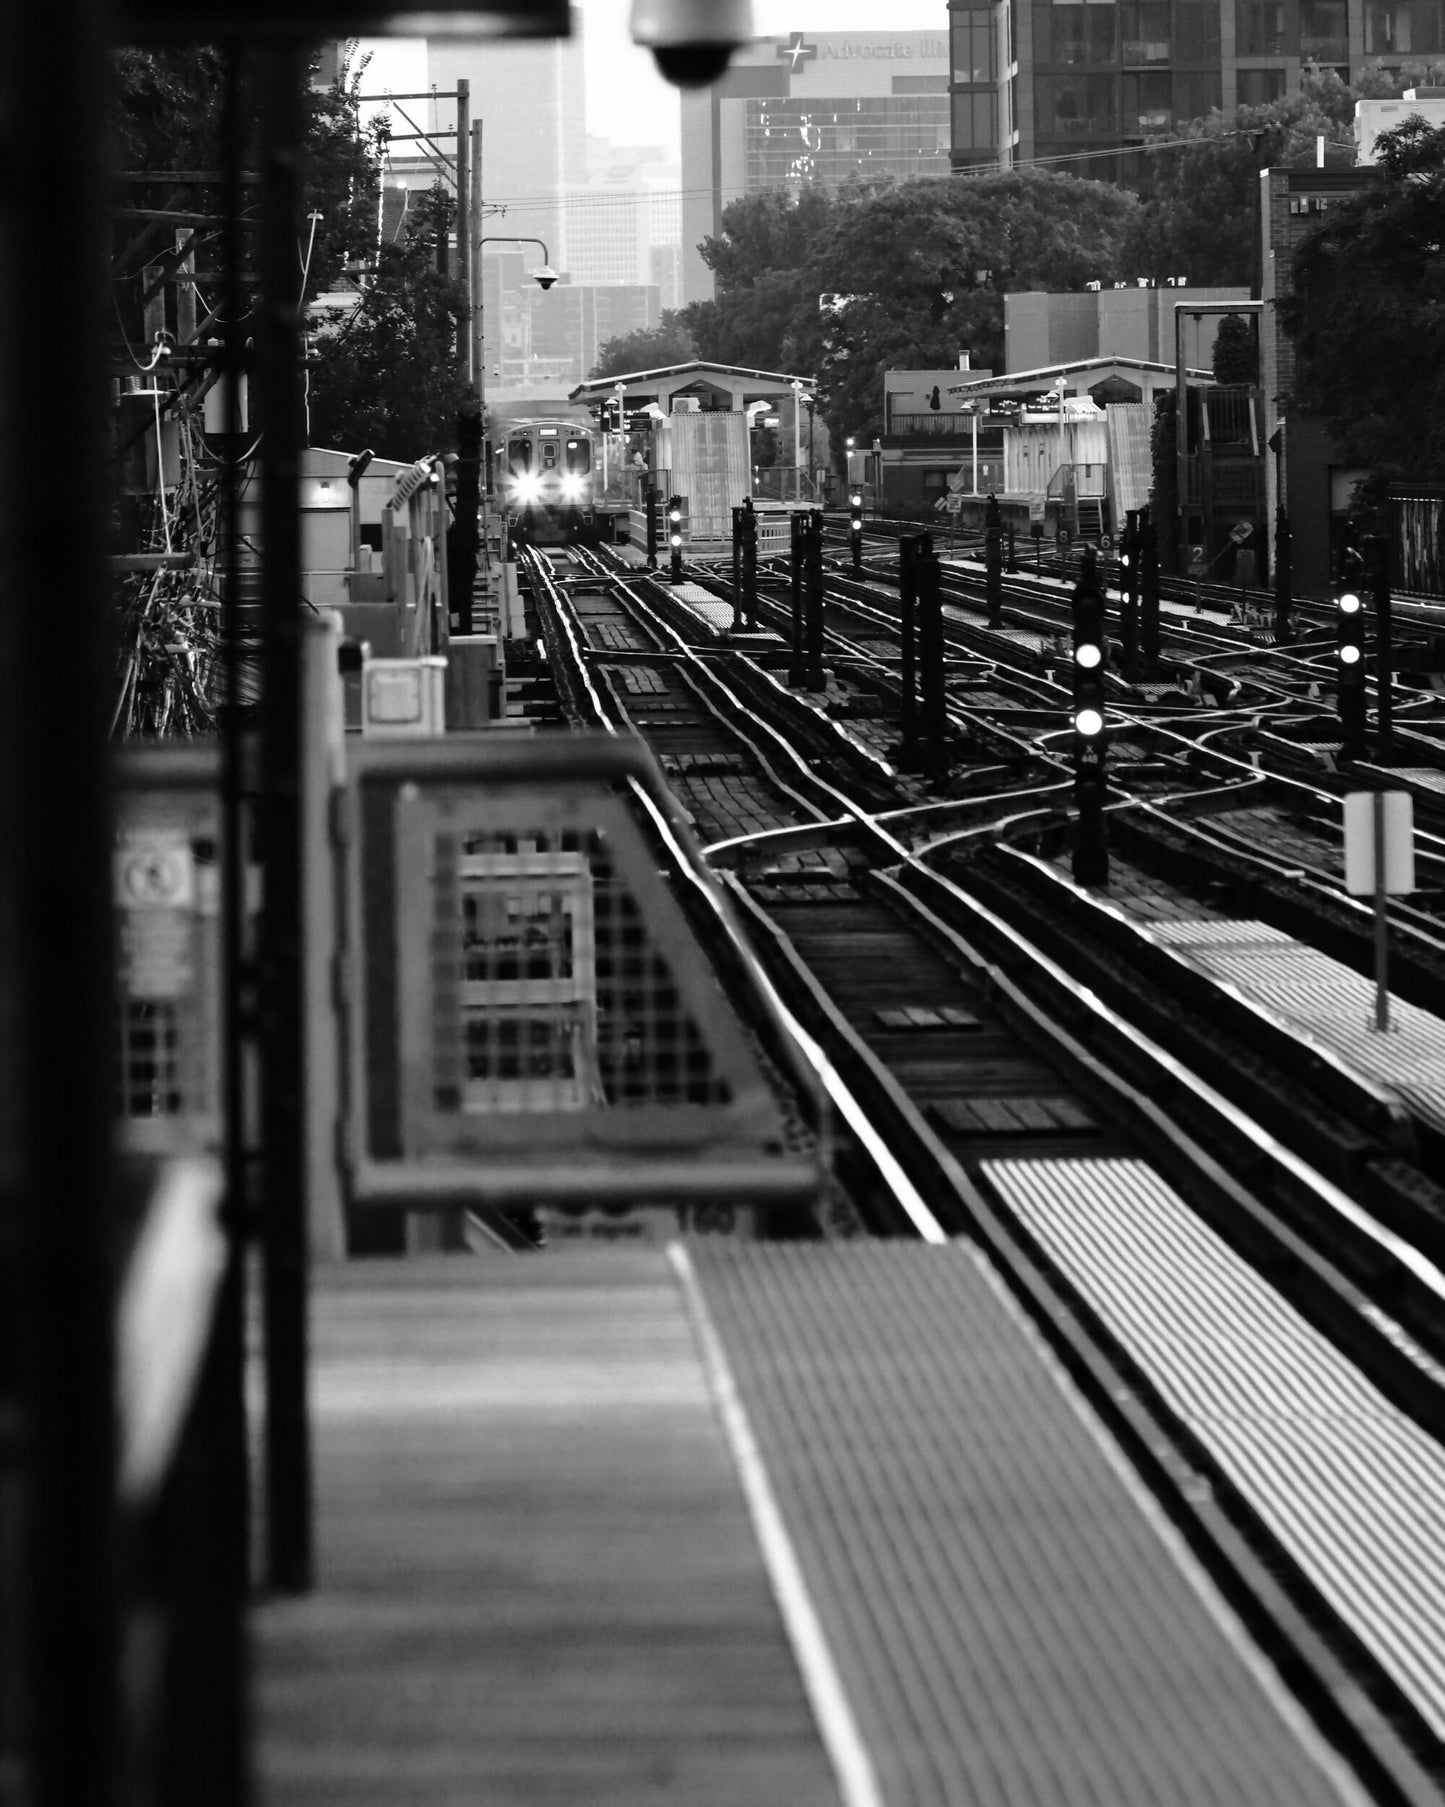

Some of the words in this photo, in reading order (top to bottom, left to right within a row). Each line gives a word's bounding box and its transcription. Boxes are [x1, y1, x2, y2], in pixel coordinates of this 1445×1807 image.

[821, 40, 913, 60] Advocate
[1059, 530, 1069, 543] 8
[1100, 535, 1111, 549] 6
[1192, 547, 1203, 562] 2
